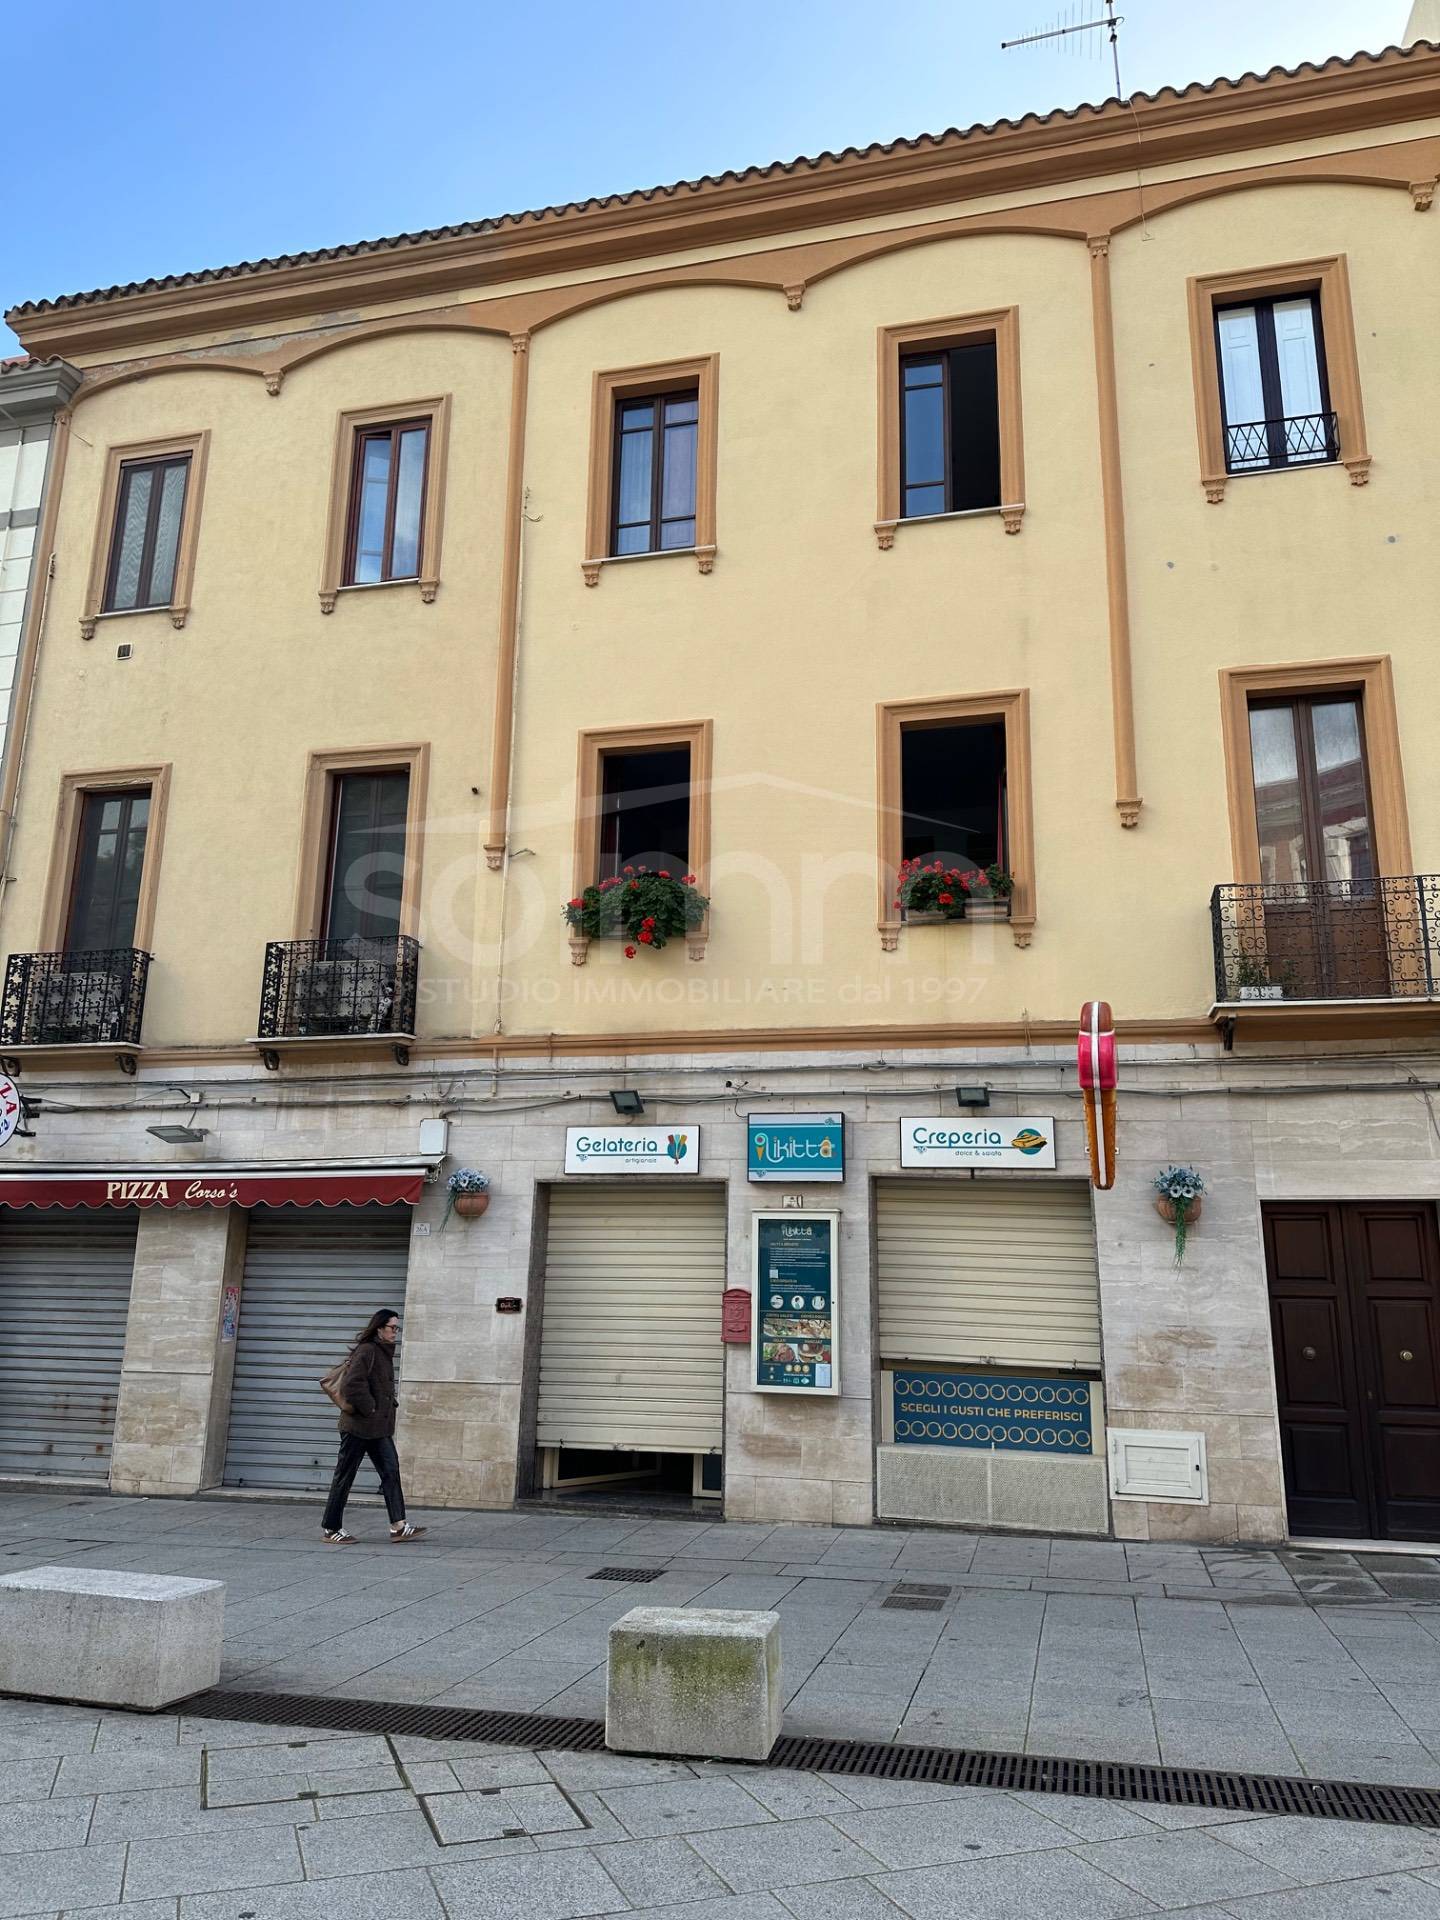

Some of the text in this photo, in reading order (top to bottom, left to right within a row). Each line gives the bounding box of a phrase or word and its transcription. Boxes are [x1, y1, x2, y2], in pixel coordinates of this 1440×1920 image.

[576, 1136, 658, 1153] Gelateria
[913, 1127, 1002, 1148] Creperia
[107, 1180, 239, 1199] PIZZA Corso's
[901, 1402, 1083, 1422] SCEGLI I GUSTI CHE PREFERISCI
